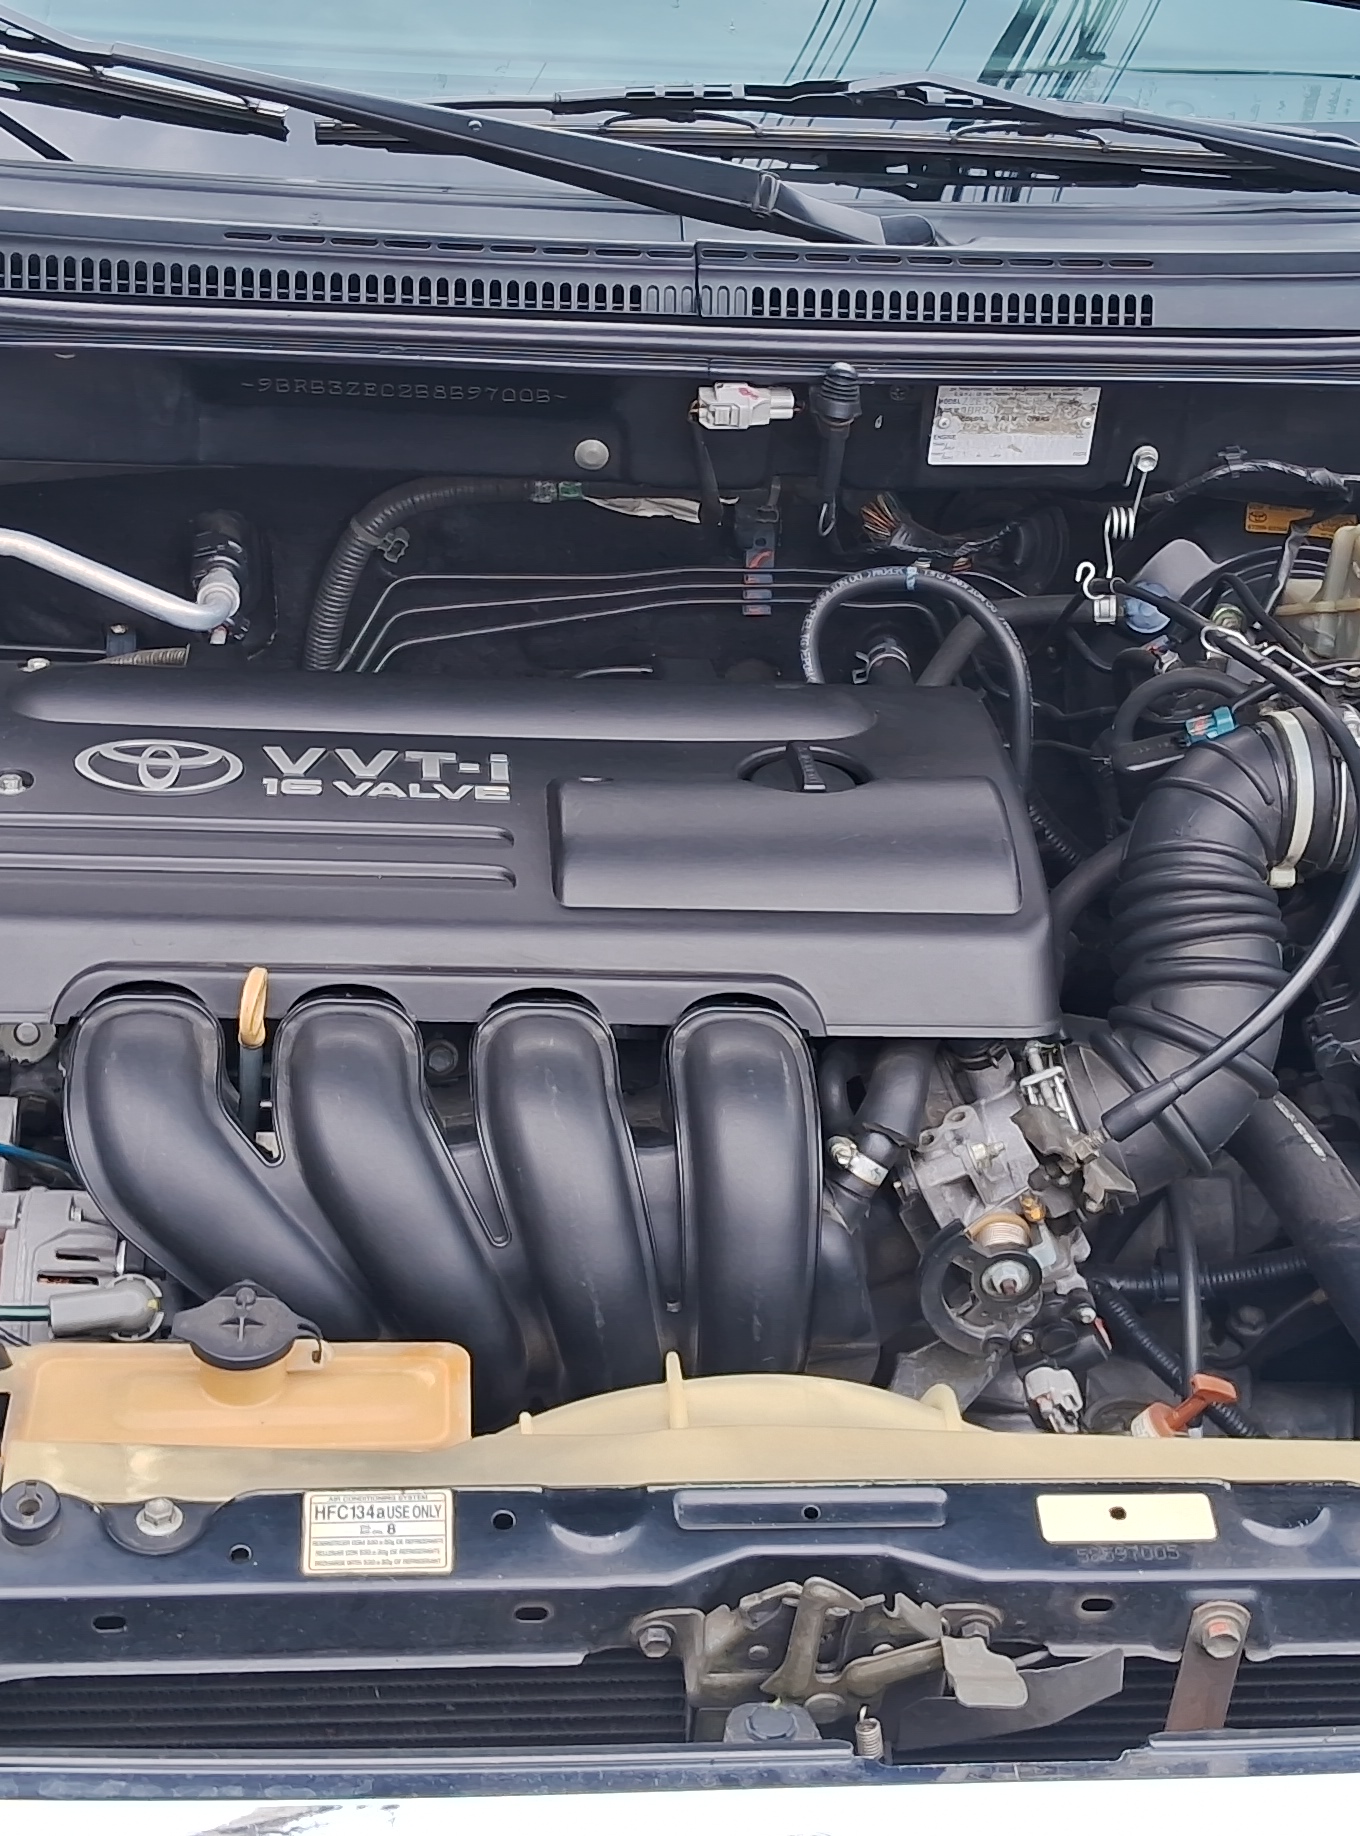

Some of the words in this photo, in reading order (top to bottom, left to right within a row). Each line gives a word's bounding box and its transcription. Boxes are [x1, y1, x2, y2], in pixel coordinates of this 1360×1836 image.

[262, 777, 323, 796] 16
[332, 781, 511, 802] VALVE
[314, 1504, 385, 1521] HFC134a
[387, 1504, 411, 1519] USE
[412, 1504, 442, 1519] ONLY
[387, 1523, 397, 1535] 8
